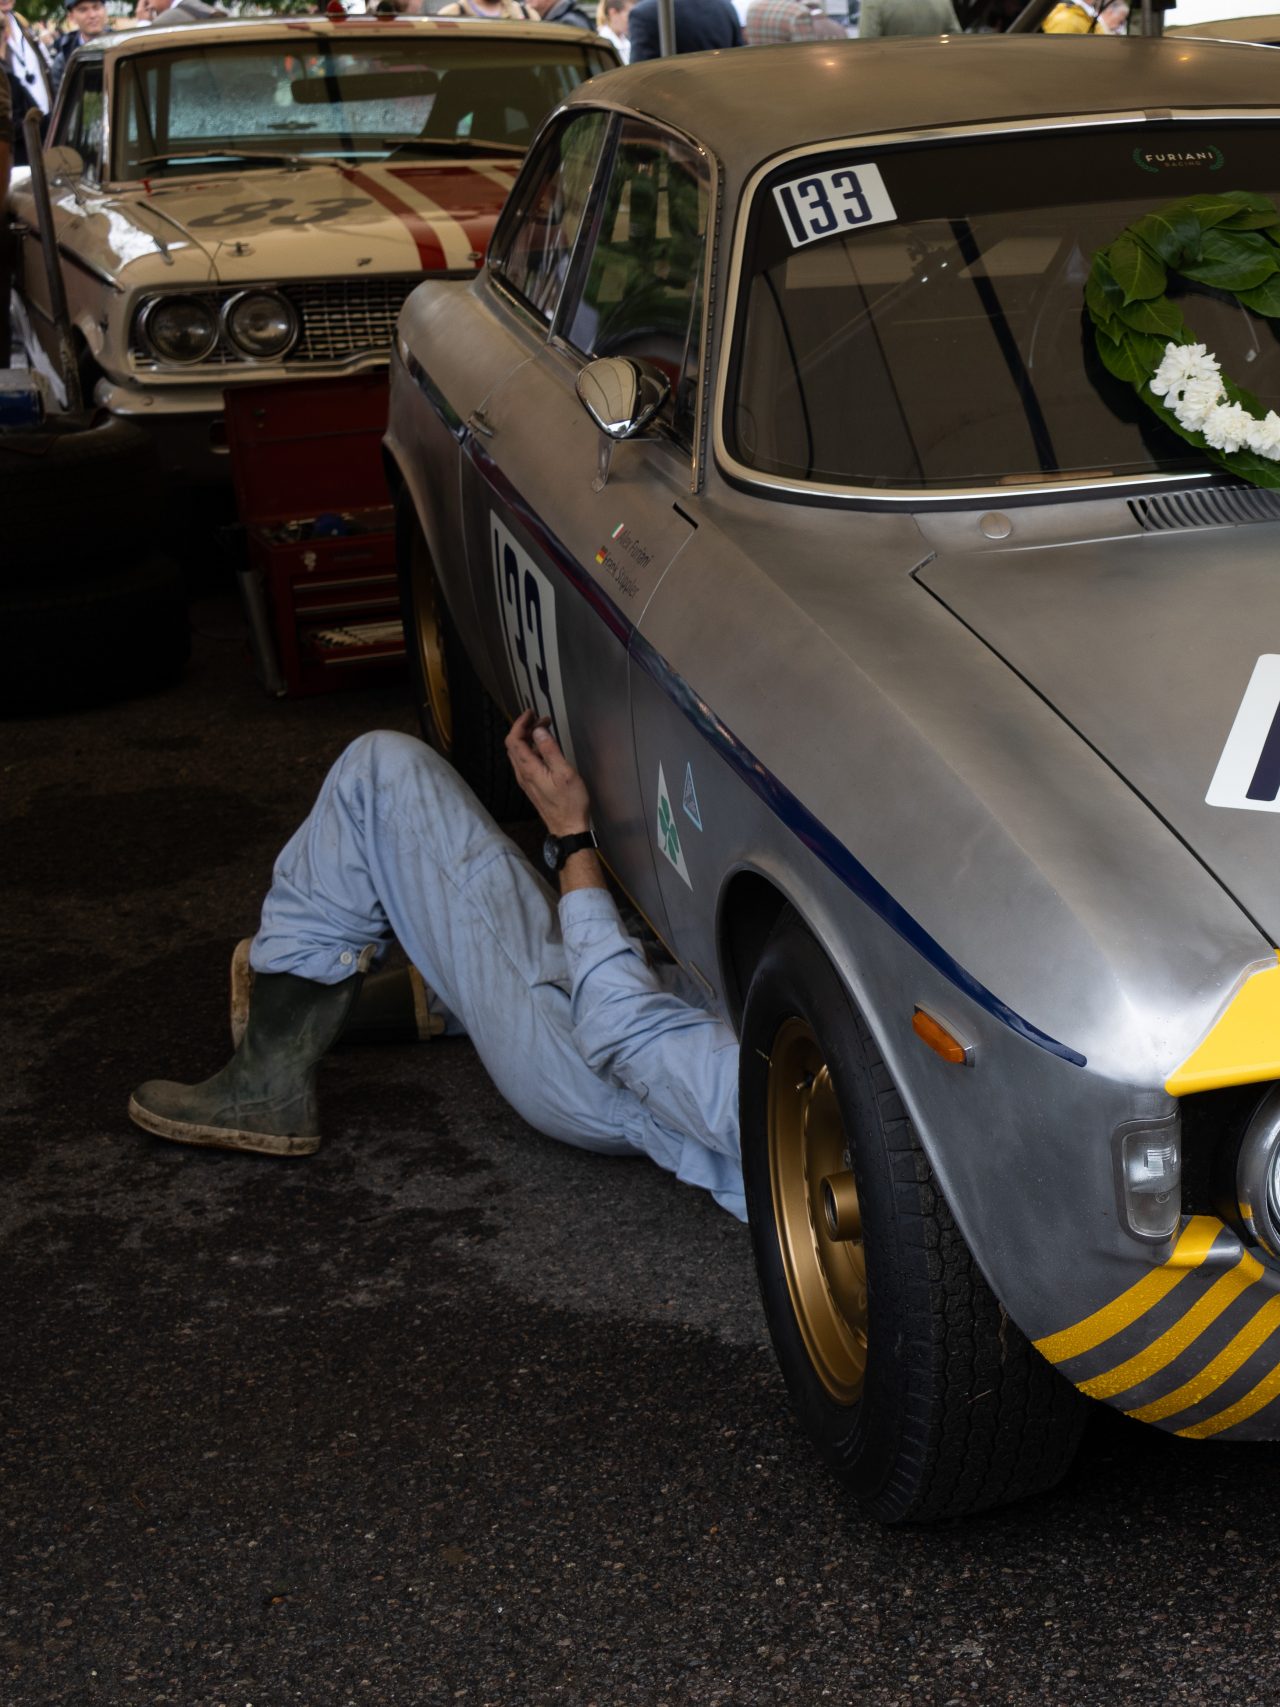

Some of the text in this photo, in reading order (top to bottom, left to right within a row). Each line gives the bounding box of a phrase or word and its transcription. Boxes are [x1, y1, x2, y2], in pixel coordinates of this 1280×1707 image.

[1144, 152, 1213, 162] FURIANI
[187, 197, 374, 228] 83
[779, 170, 873, 243] 133
